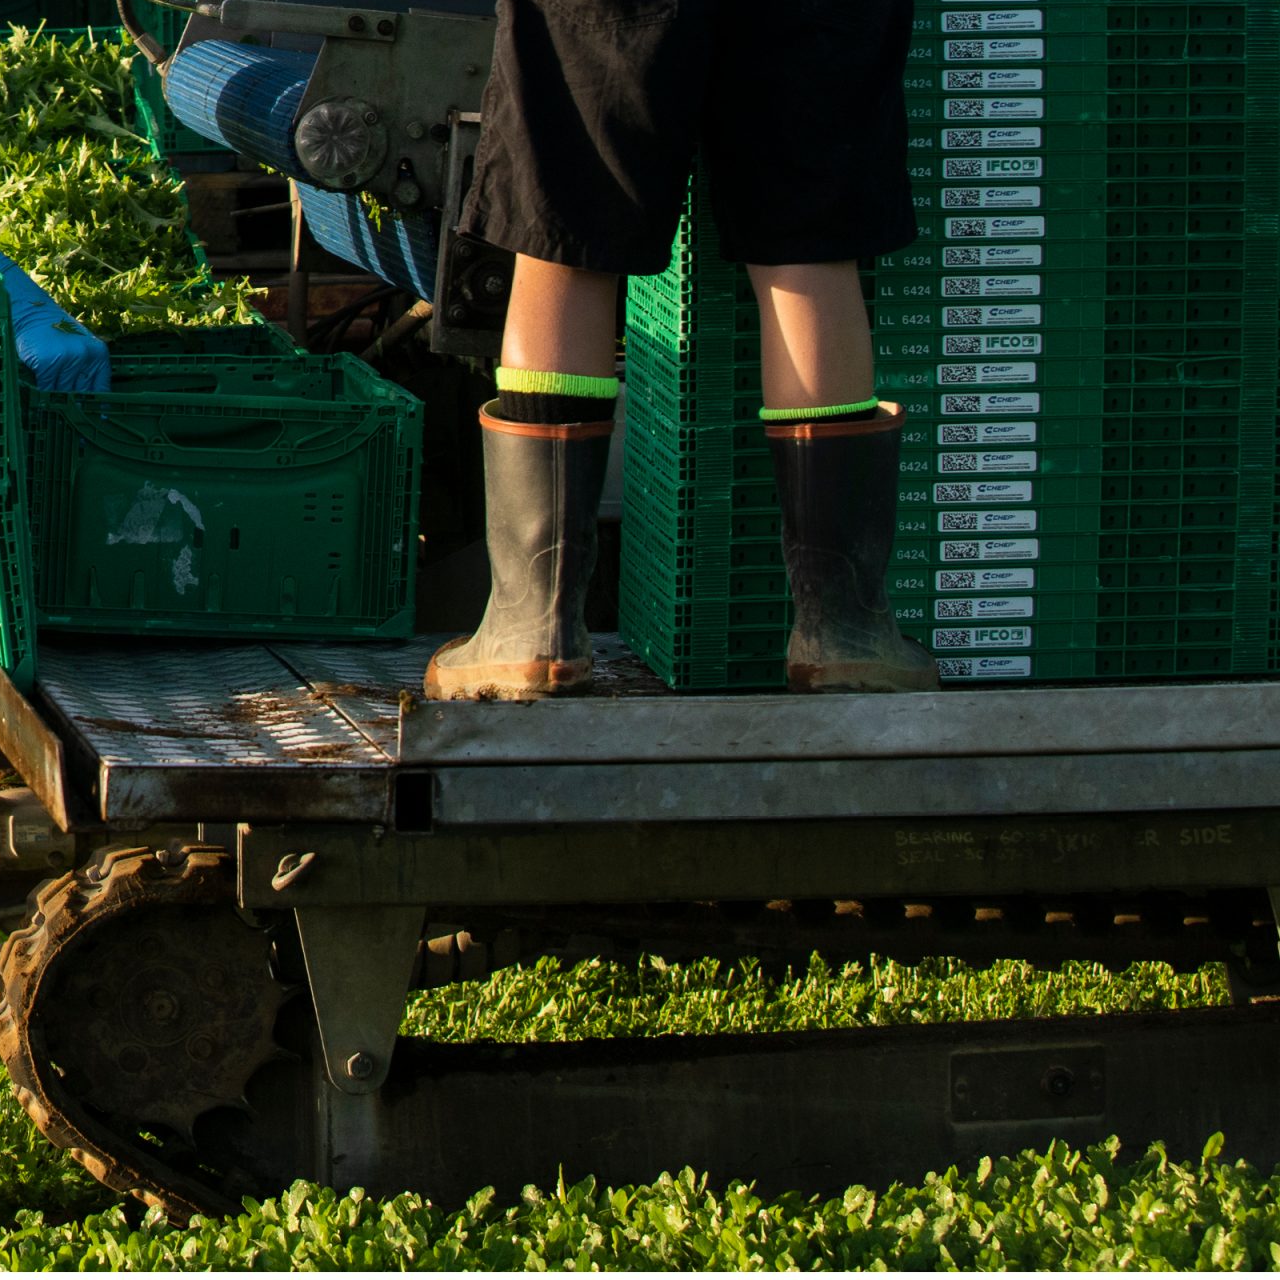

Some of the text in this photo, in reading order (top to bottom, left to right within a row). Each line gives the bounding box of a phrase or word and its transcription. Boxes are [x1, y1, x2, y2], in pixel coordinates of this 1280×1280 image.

[907, 48, 932, 58] 424
[903, 79, 933, 89] 6424
[907, 138, 933, 148] 424
[986, 160, 1022, 171] IFCO
[908, 167, 932, 177] 424
[881, 256, 931, 267] LL 6424
[881, 286, 931, 296] LL 6424
[880, 314, 931, 325] LL 6424
[986, 336, 1021, 348] IFCO
[880, 344, 930, 355] LL 6424
[908, 403, 929, 413] 424
[899, 461, 928, 472] 6424
[899, 491, 927, 502] 6424
[898, 521, 927, 531] 6424
[896, 549, 925, 560] 6424
[895, 578, 925, 589] 6424
[895, 608, 923, 619] 6424
[975, 629, 1009, 641] IFCO
[895, 830, 974, 846] BEARING
[1180, 823, 1232, 845] SIDE
